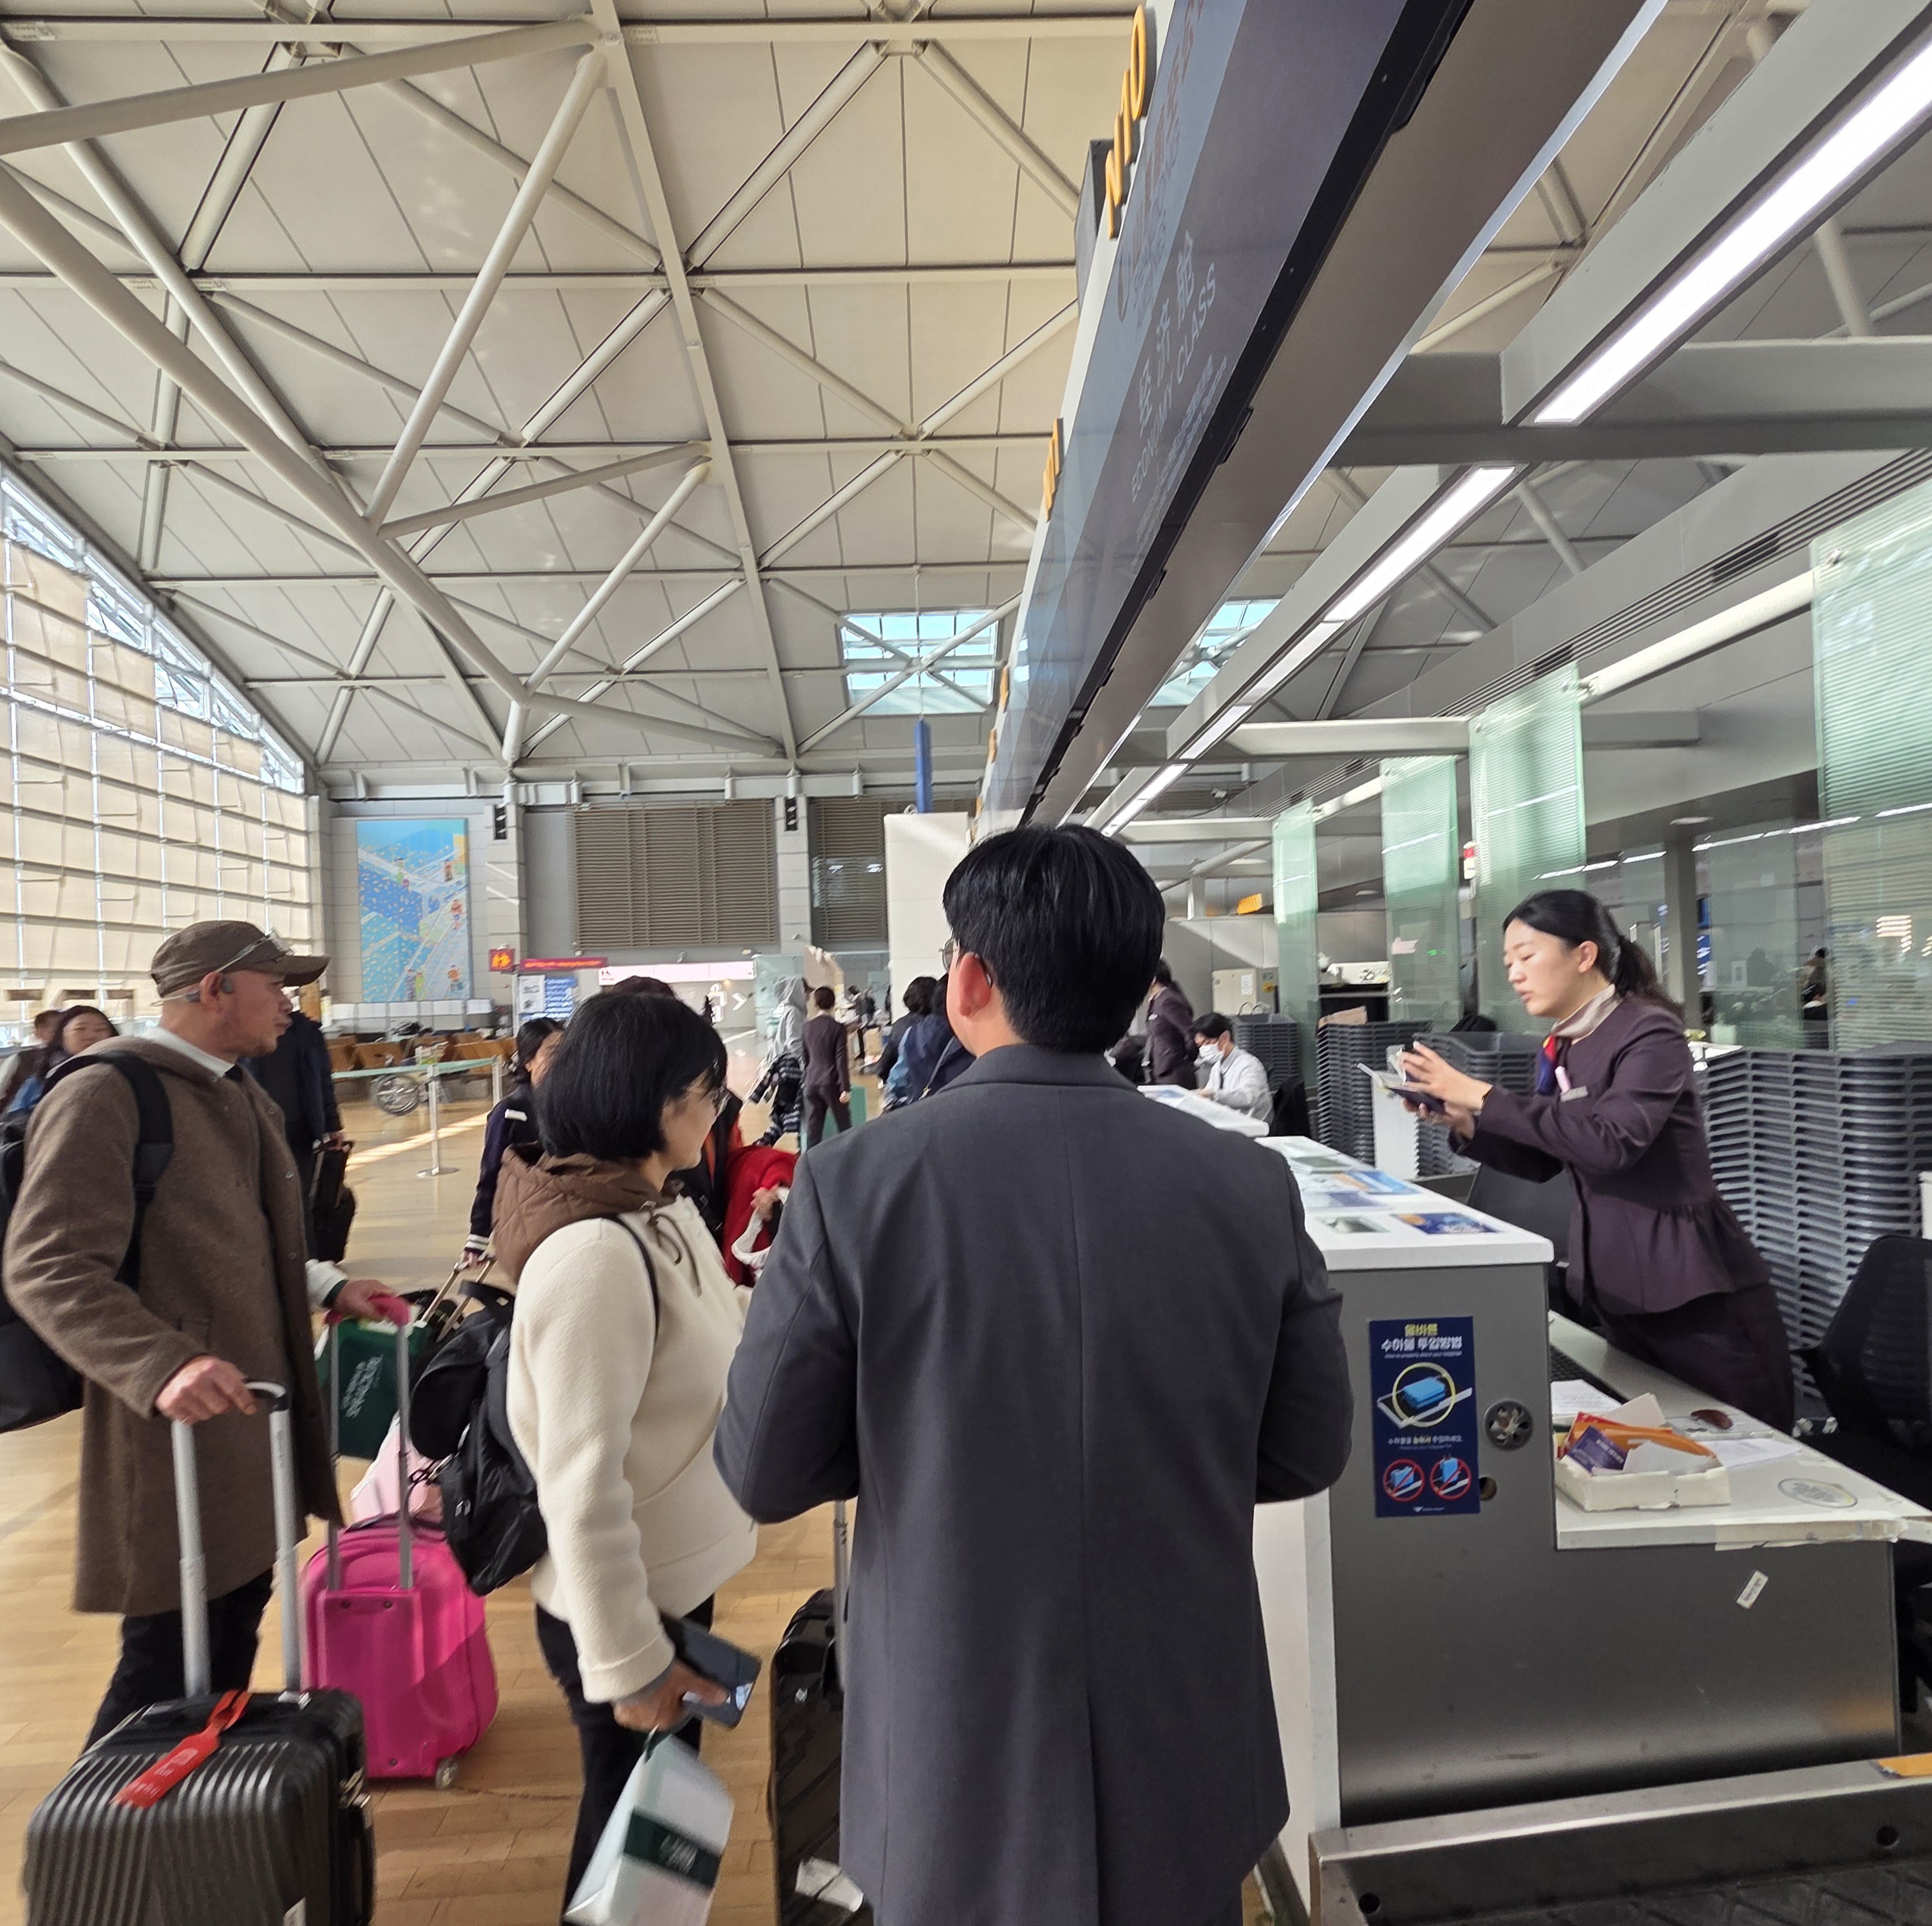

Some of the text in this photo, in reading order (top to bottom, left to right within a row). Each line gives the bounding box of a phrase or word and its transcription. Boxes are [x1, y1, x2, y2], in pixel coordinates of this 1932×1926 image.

[1105, 4, 1147, 241] N10
[1132, 370, 1173, 503] ECONOMY
[1176, 262, 1216, 384] CLASS
